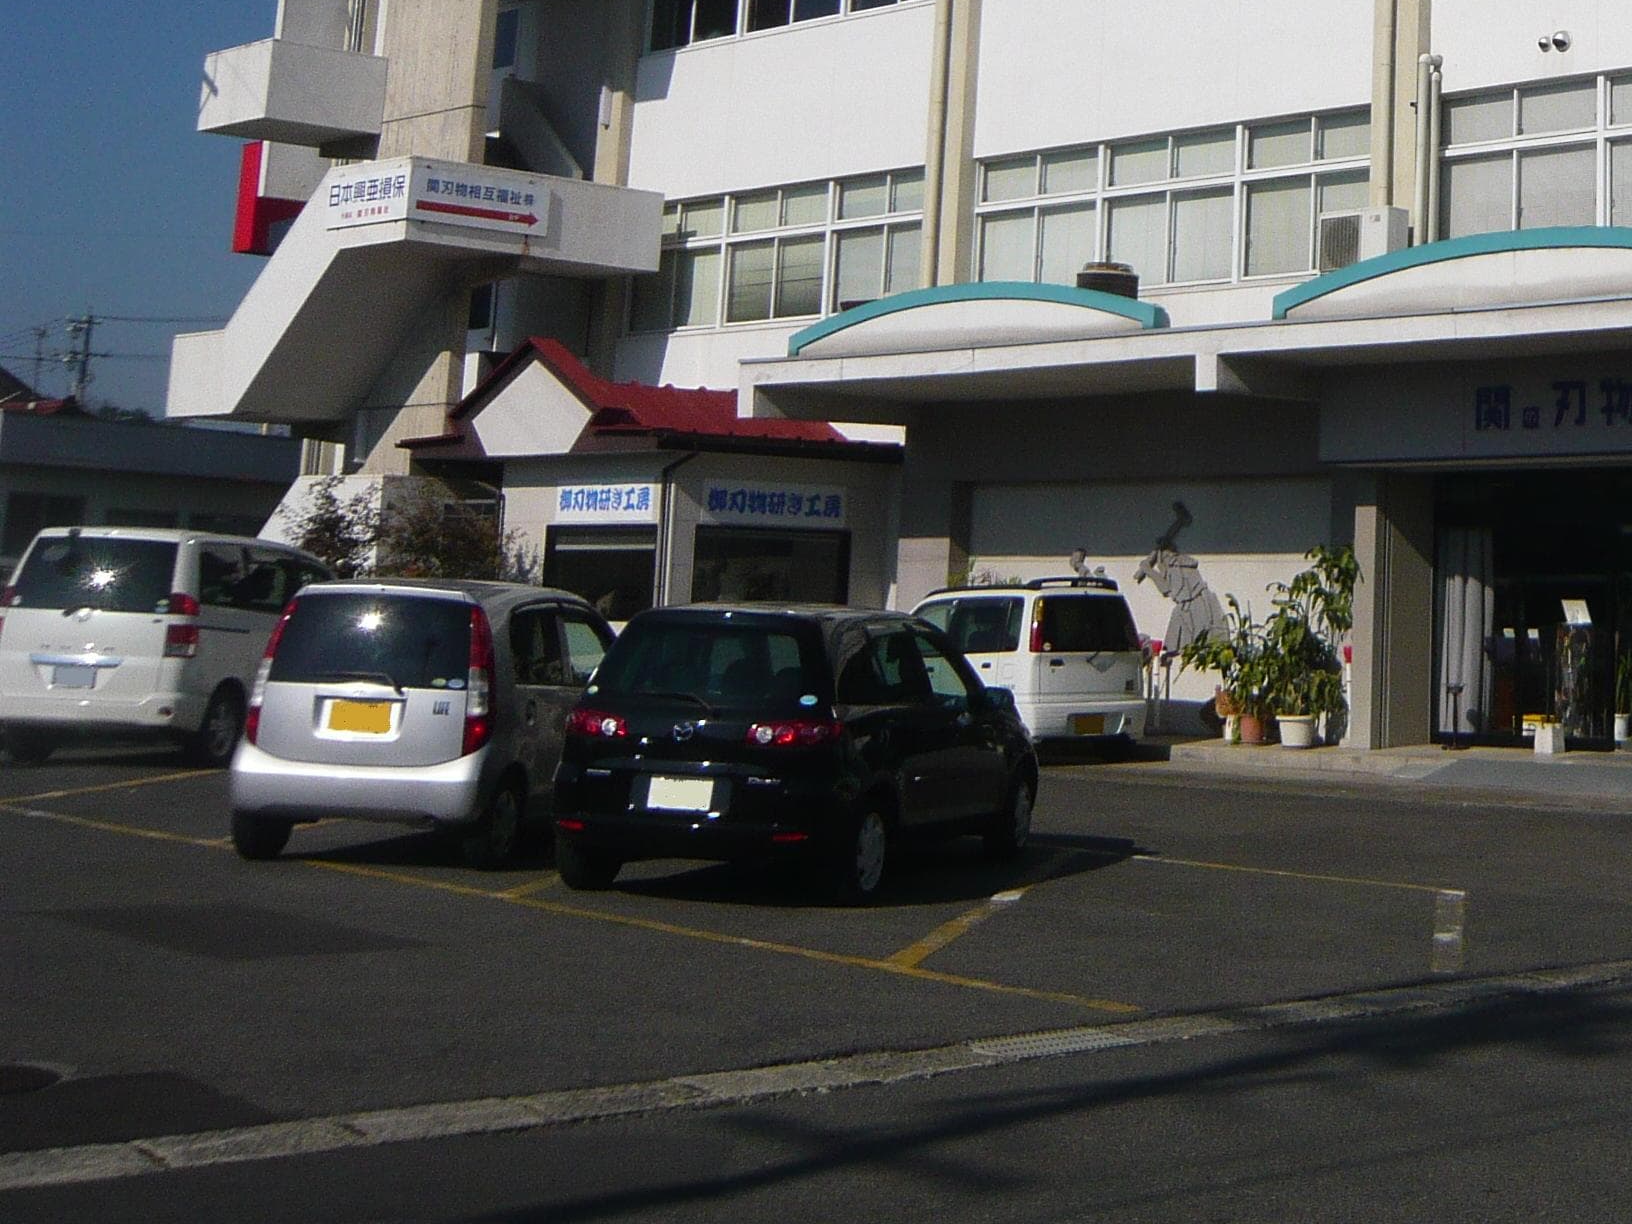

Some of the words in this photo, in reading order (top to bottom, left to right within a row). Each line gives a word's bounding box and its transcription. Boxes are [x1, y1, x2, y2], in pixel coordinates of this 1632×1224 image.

[329, 175, 406, 207] 日本興亜損保
